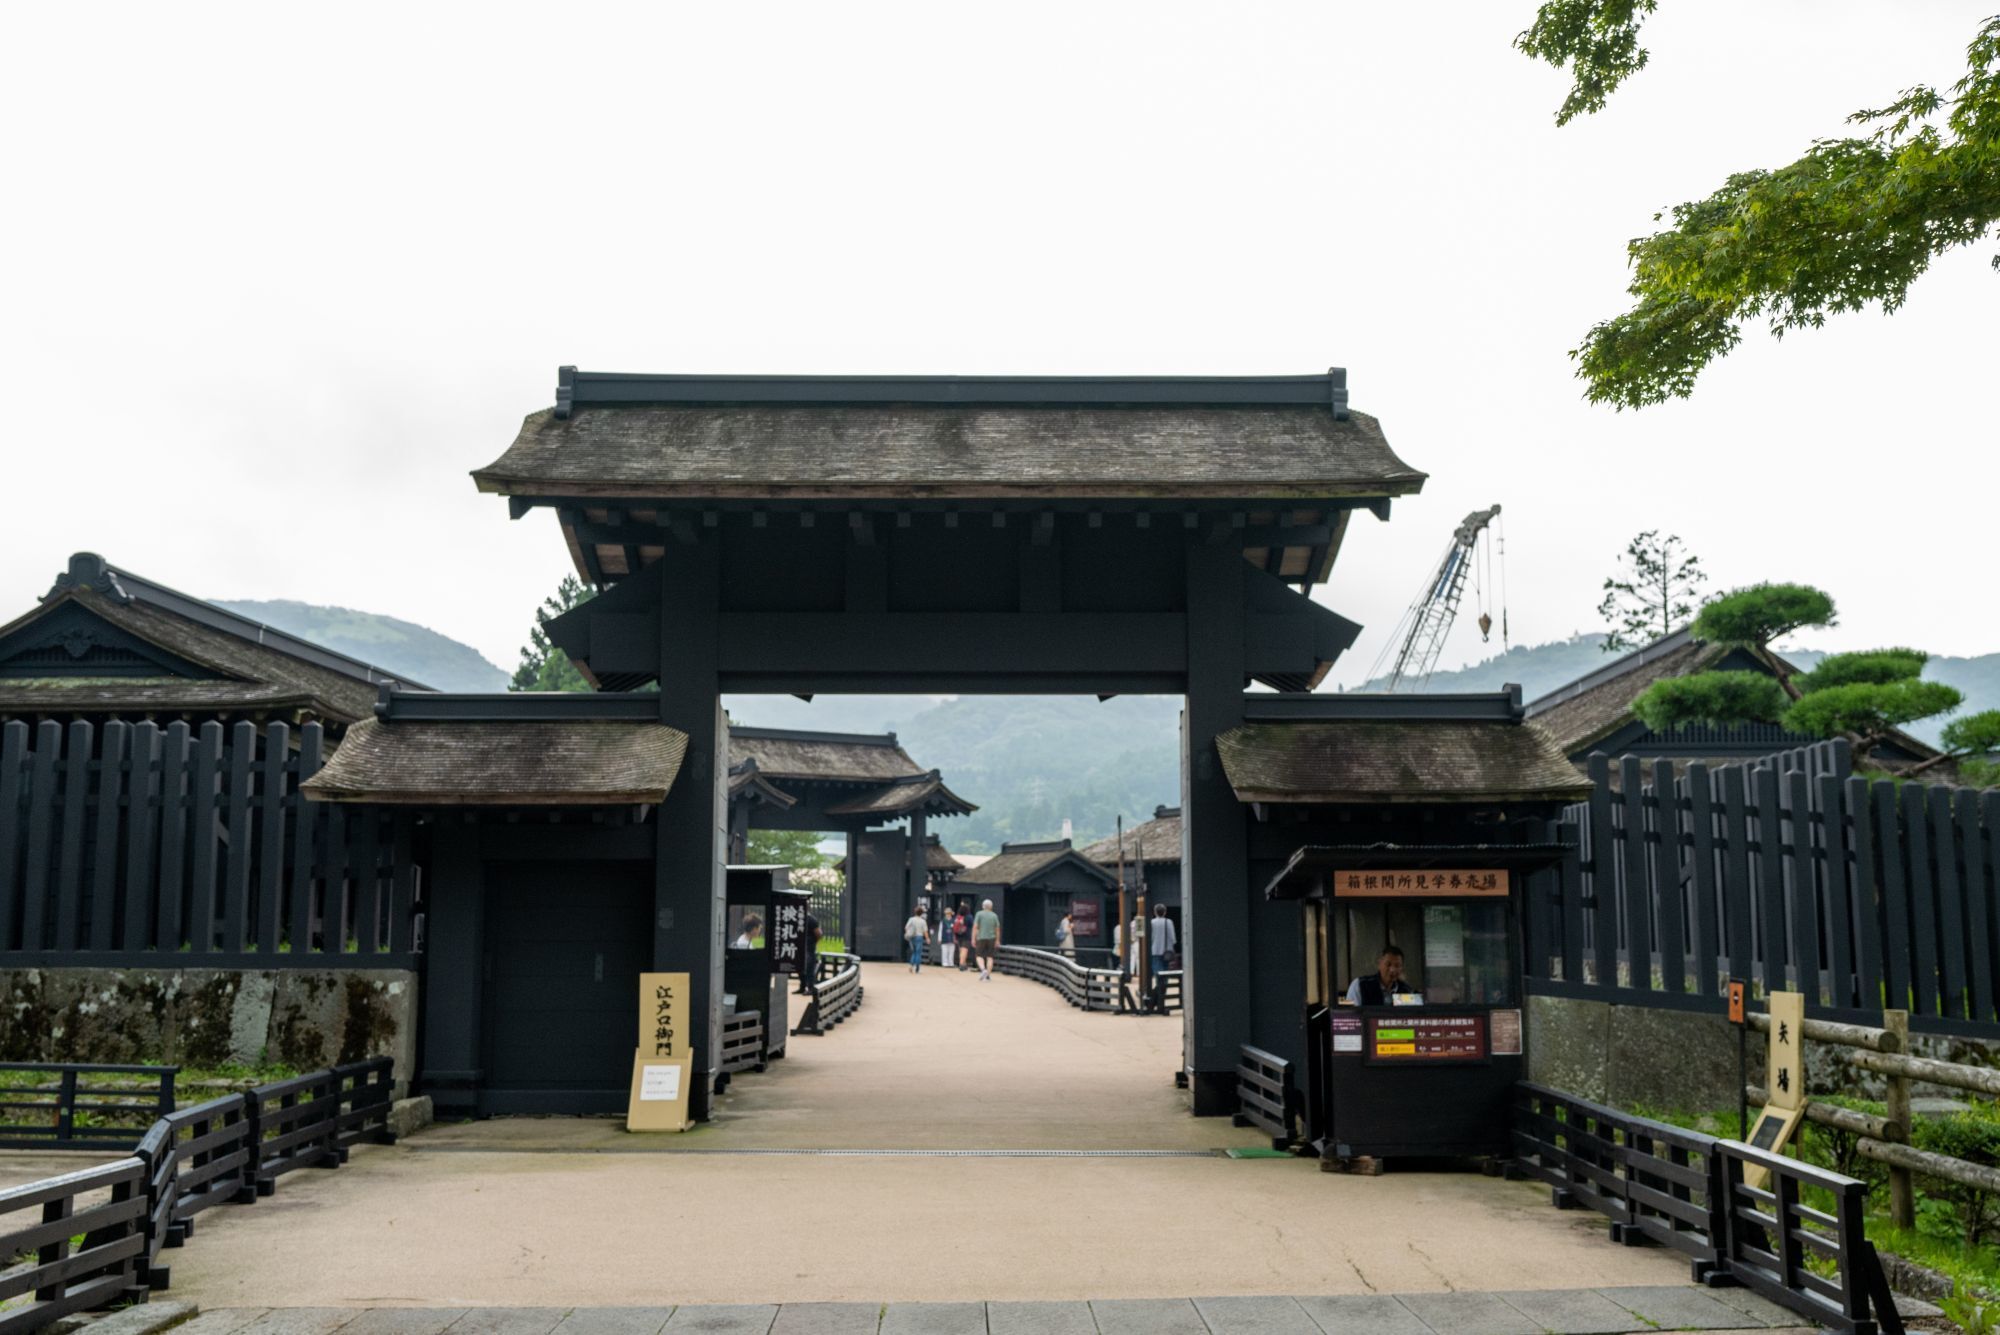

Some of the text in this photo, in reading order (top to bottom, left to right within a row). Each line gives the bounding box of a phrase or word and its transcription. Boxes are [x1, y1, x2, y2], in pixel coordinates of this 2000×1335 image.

[780, 905, 798, 960] 検札所
[654, 985, 674, 1056] 江戸口御門
[1777, 1020, 1790, 1093] 矢場
